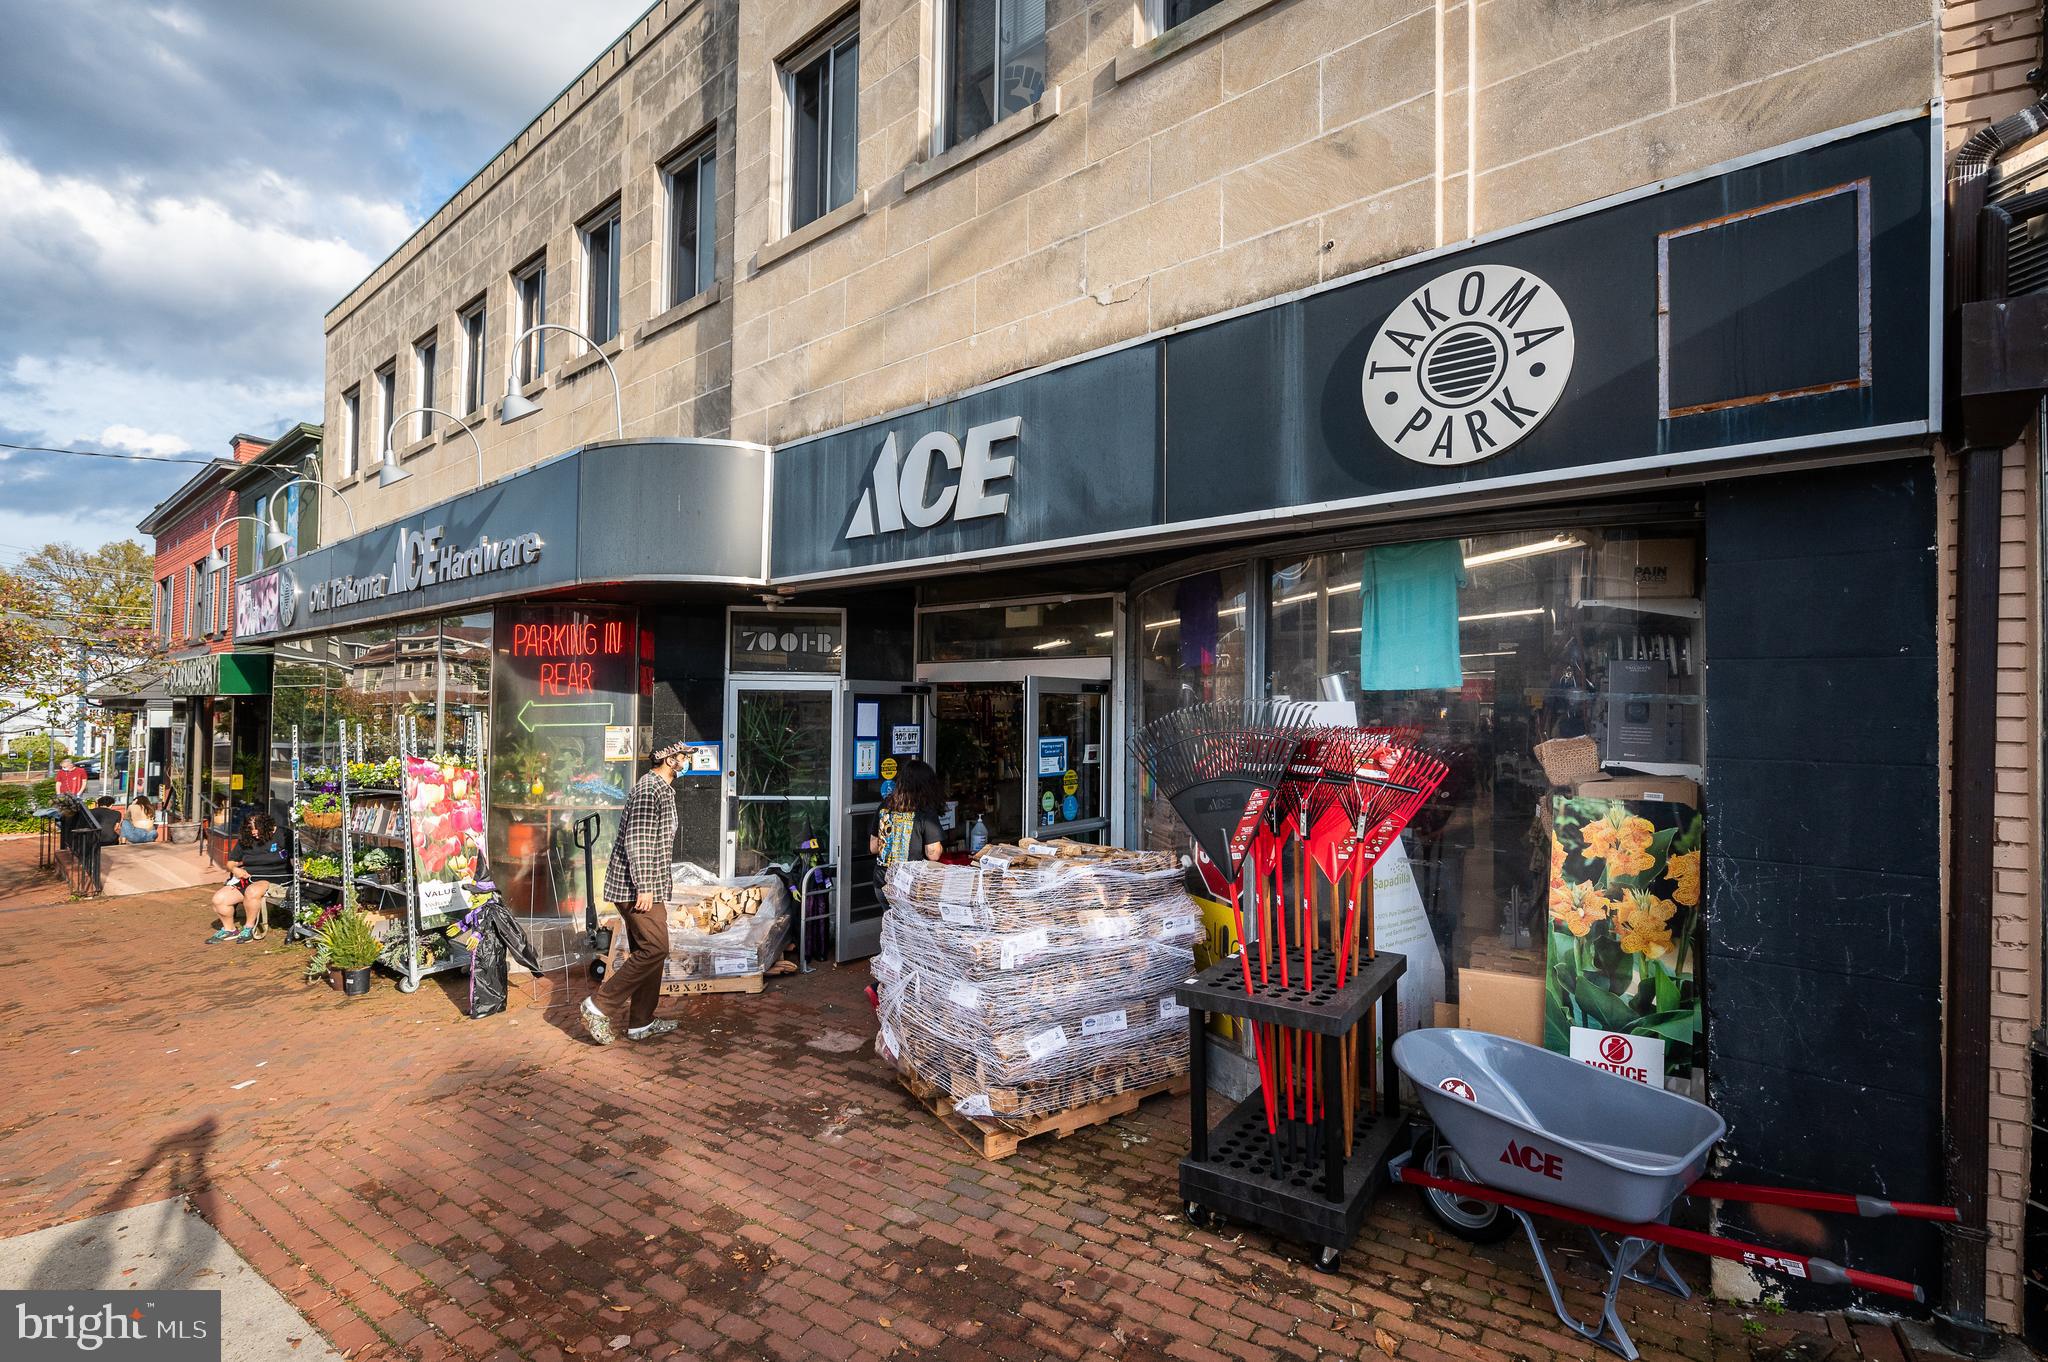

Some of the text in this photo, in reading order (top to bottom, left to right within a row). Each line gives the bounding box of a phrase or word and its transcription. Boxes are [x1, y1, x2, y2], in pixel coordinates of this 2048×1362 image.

[1368, 271, 1565, 380] TAKOMA
[1394, 386, 1539, 458] PARK
[845, 416, 1023, 539] ACE
[309, 580, 327, 613] Old
[329, 573, 386, 608] Takoma
[387, 525, 444, 594] ACE
[439, 531, 541, 582] Hardware
[1634, 566, 1666, 577] PAIN
[514, 622, 622, 656] PARKING IN
[742, 631, 832, 653] 7001-B
[540, 662, 593, 696] REAR
[1208, 798, 1232, 811] ACE
[425, 887, 457, 898] VALUE
[1374, 872, 1411, 890] Sapadilla
[666, 984, 680, 993] 42
[683, 983, 691, 992] X
[1585, 1060, 1648, 1084] TICE
[1499, 1139, 1563, 1181] ACE
